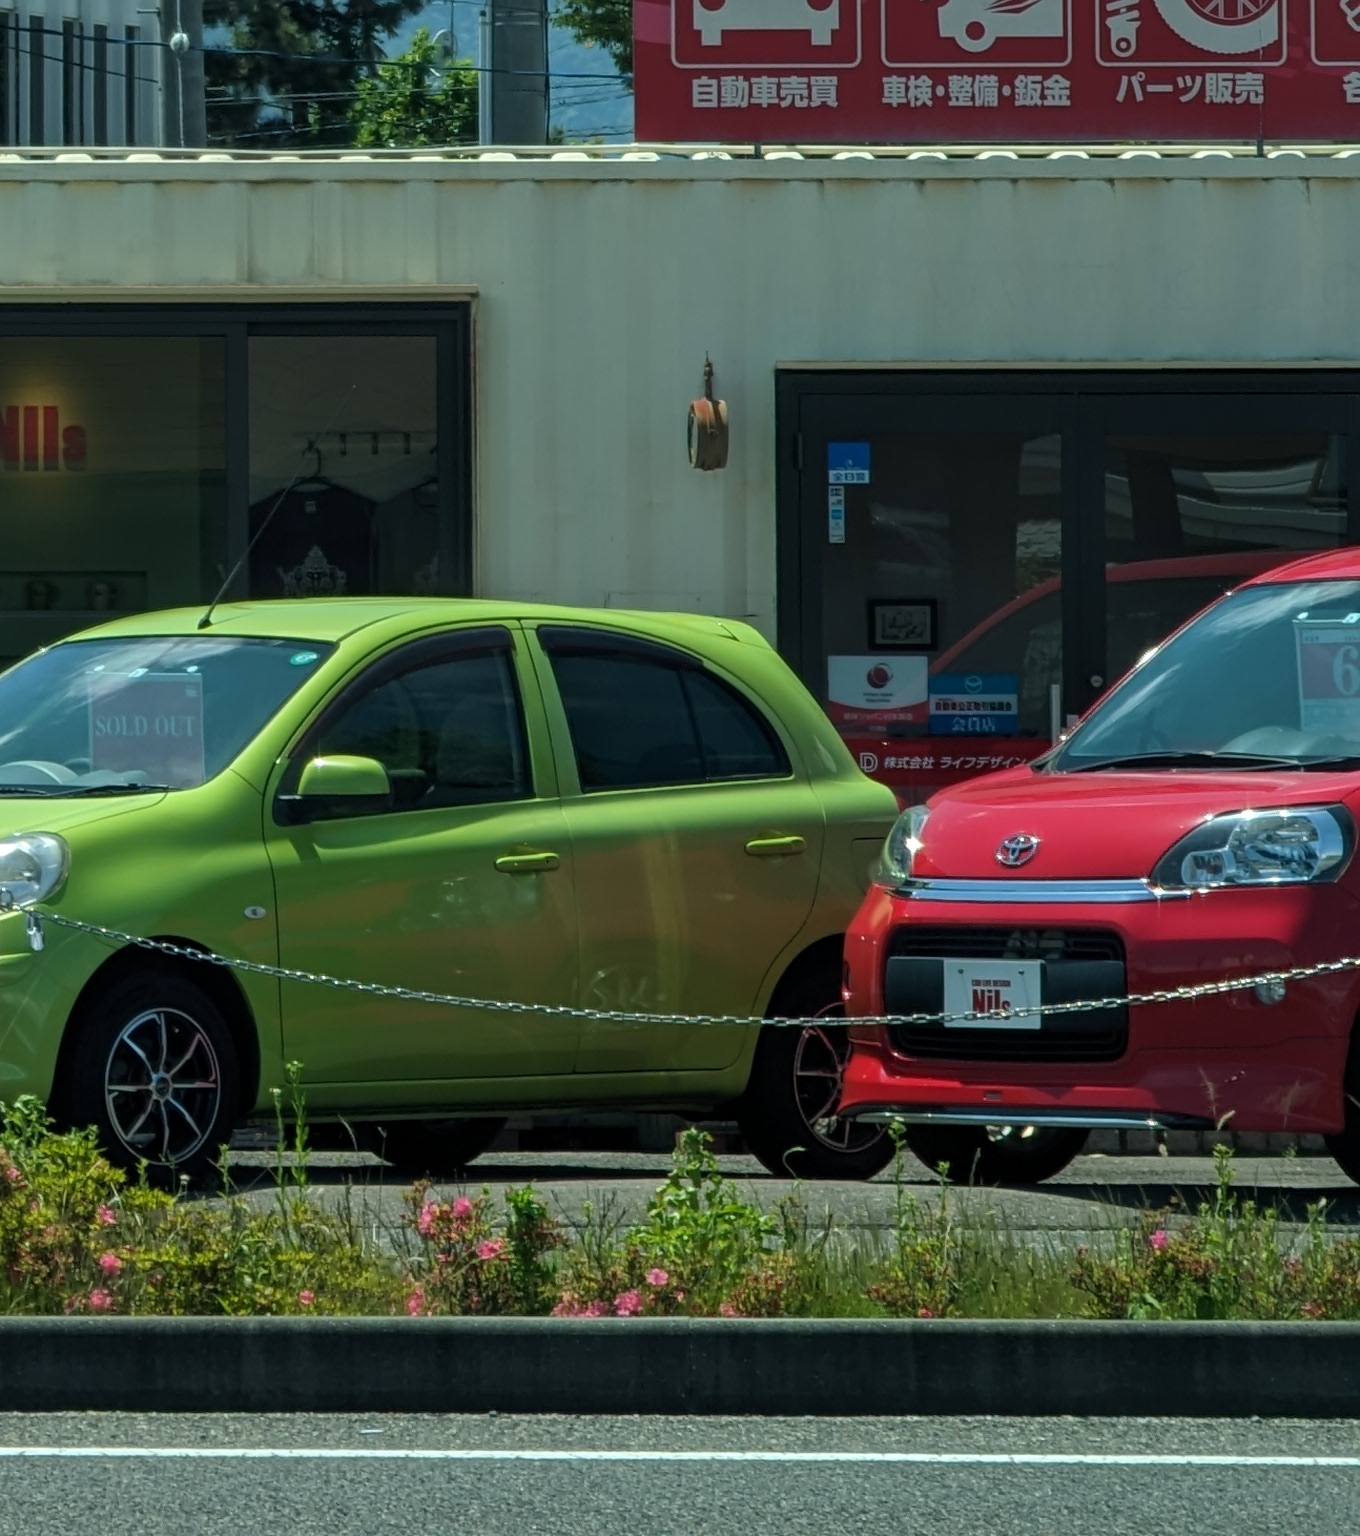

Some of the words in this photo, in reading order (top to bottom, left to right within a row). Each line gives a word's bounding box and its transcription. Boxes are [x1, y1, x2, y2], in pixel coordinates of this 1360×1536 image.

[692, 75, 838, 108] 自動車売買
[1115, 71, 1264, 105] パーツ販売
[95, 715, 148, 737] SOLD
[155, 715, 196, 737] OUT
